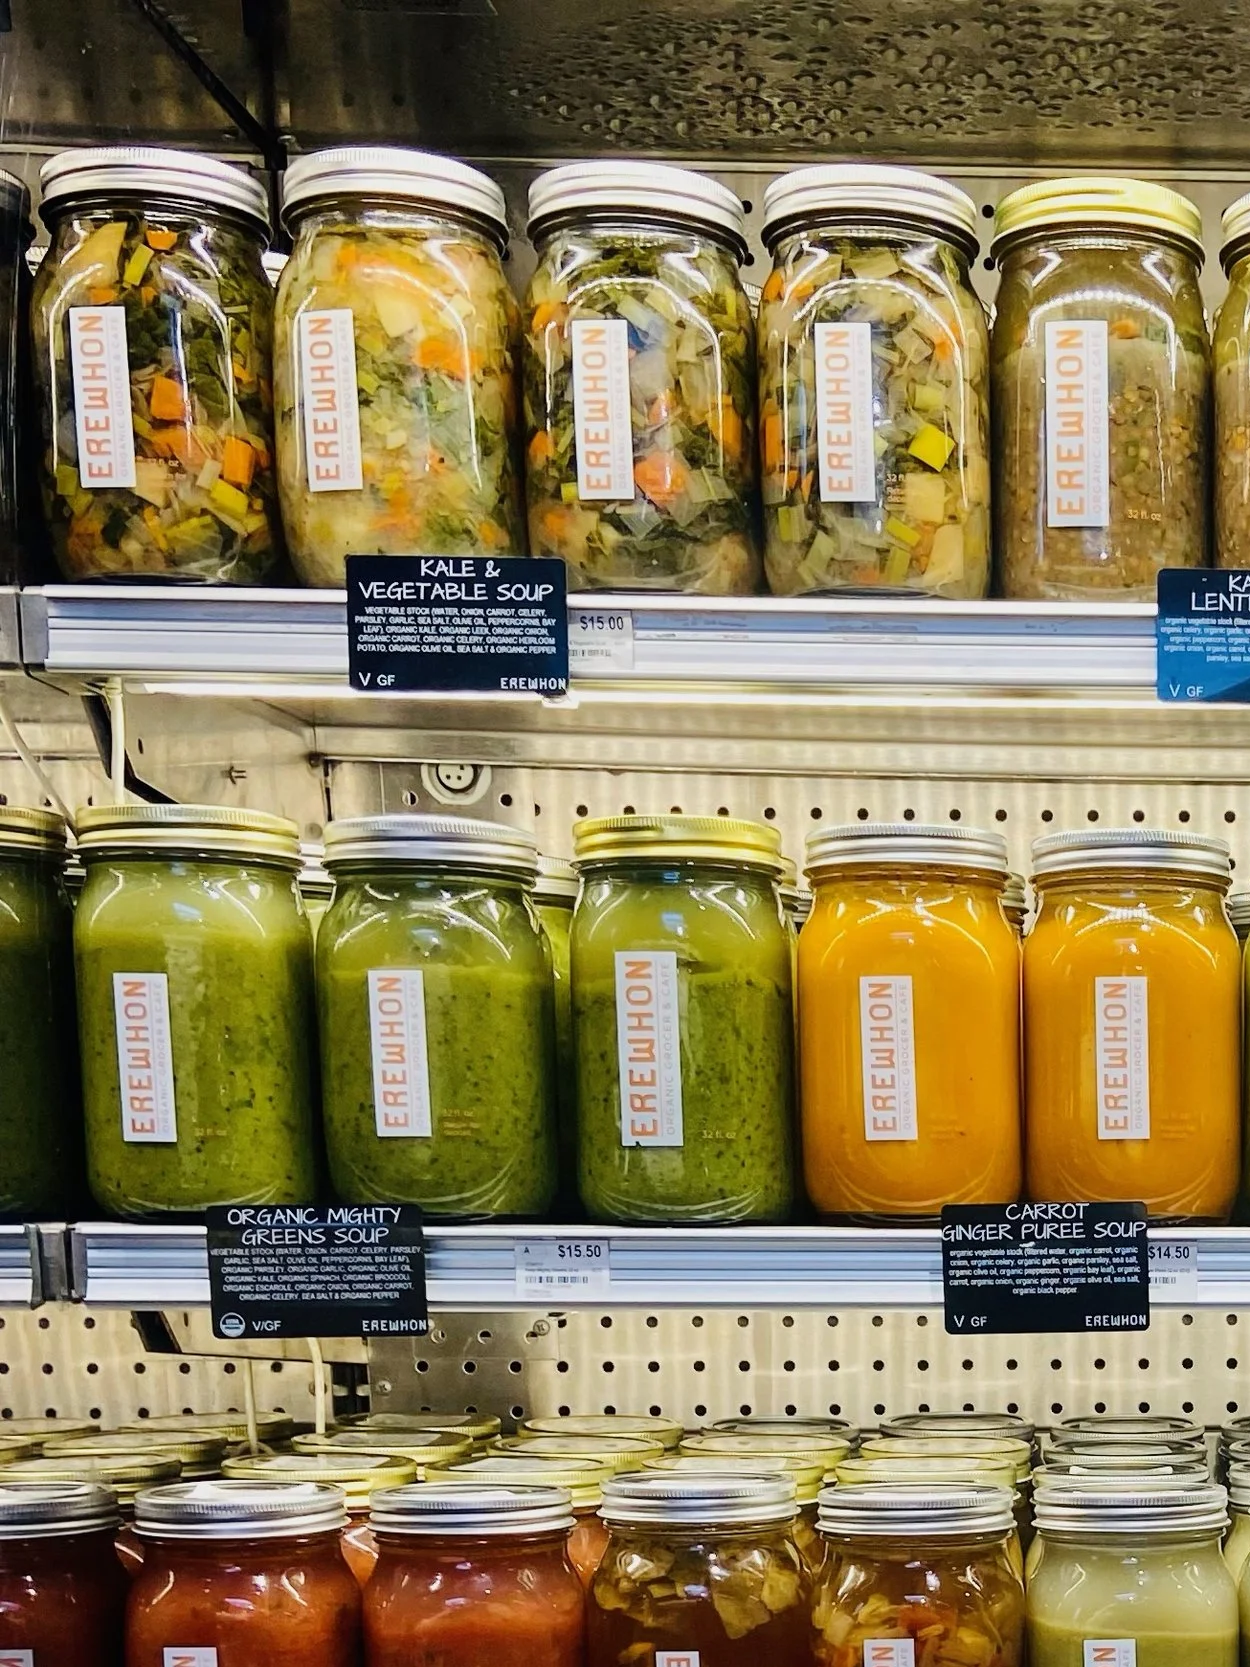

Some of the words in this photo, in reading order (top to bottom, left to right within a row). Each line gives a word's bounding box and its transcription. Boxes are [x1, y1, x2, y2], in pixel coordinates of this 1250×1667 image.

[78, 313, 114, 480] EREWHON
[582, 328, 612, 491] EREWHON
[1055, 328, 1084, 515] EREWHON
[420, 558, 477, 578] KALE
[484, 559, 501, 578] &
[358, 581, 489, 601] VEGETABLE
[496, 583, 554, 602] SOUP
[579, 615, 624, 631] $15.00
[358, 671, 371, 687] V
[376, 673, 396, 687] GF
[498, 677, 566, 693] EREWHON
[1167, 683, 1181, 701] V
[1186, 685, 1204, 701] GF
[625, 959, 659, 1137] EREWHON
[663, 1017, 672, 1069] GROCER
[121, 979, 156, 1135] EREWHON
[867, 981, 895, 1132] EREWHON
[664, 1076, 675, 1134] ORGANIC
[227, 1207, 319, 1227] ORGANIC
[326, 1206, 402, 1230] MIGHTY
[1005, 1202, 1090, 1221] CARROT
[241, 1228, 327, 1246] GREENS
[334, 1227, 390, 1244] SOUP
[942, 1223, 1014, 1243] GINGER
[1021, 1222, 1086, 1244] PUREE
[1093, 1221, 1147, 1239] SOUP
[557, 1244, 602, 1259] $15.50
[1148, 1245, 1190, 1260] $14.50
[252, 1320, 282, 1332] V/GF
[362, 1318, 427, 1332] EREWHON
[953, 1314, 965, 1328] V
[970, 1315, 988, 1328] GF
[1085, 1314, 1147, 1327] EREWHON
